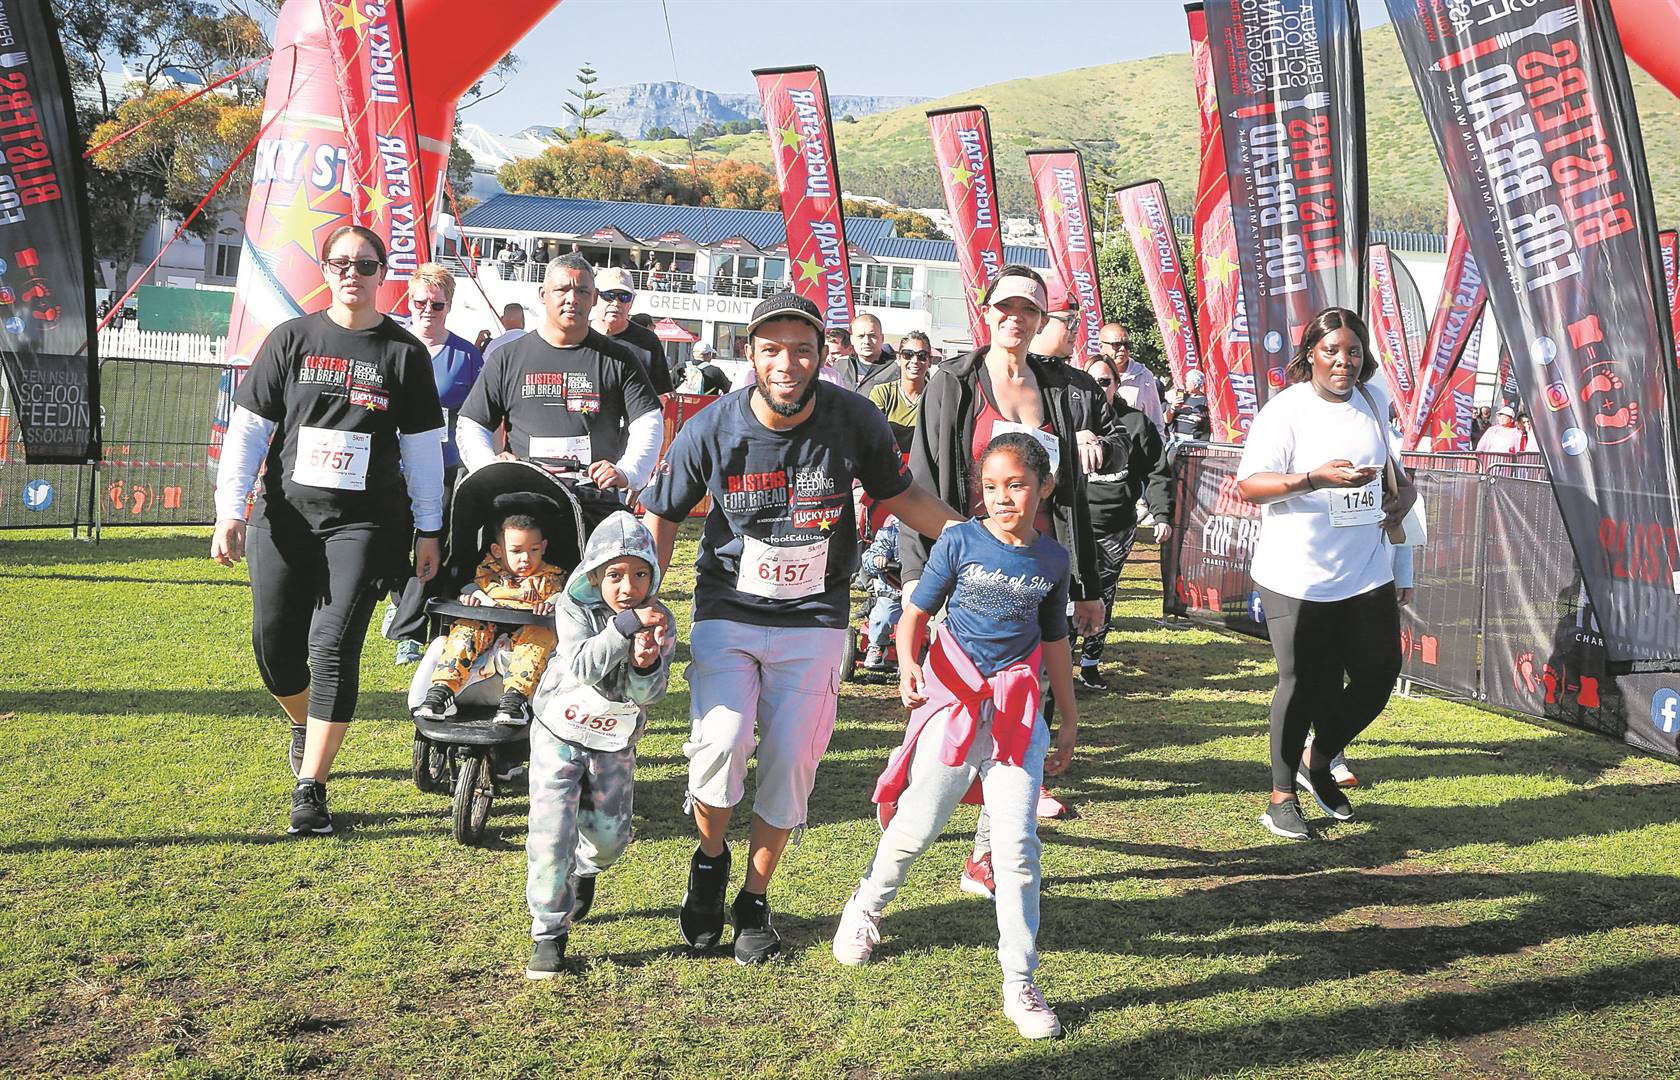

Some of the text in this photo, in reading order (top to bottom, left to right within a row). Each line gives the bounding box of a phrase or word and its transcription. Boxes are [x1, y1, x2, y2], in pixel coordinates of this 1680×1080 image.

[650, 295, 701, 312] GREEN
[707, 299, 752, 315] POINT
[304, 355, 348, 373] BLISTERS
[299, 367, 315, 382] FOR
[316, 368, 346, 384] BREAD
[353, 370, 383, 384] FEEDING
[525, 373, 562, 386] BLISTERS
[20, 383, 89, 405] SCHOOL
[351, 391, 373, 402] LUCKY
[373, 396, 389, 409] STAR
[521, 385, 536, 397] FOR
[537, 384, 562, 396] BREAD
[310, 449, 355, 471] 5757
[727, 470, 787, 493] BLISTERS
[796, 470, 825, 481] SCHOOL
[796, 478, 835, 491] FEEDING
[723, 493, 746, 510] FOR
[748, 487, 788, 508] BREAD
[1343, 489, 1375, 510] 1746
[795, 510, 823, 525] LUCKY
[1202, 514, 1234, 557] FOR
[758, 562, 810, 583] 6157
[1008, 573, 1026, 592] of
[564, 704, 619, 732] 6159
